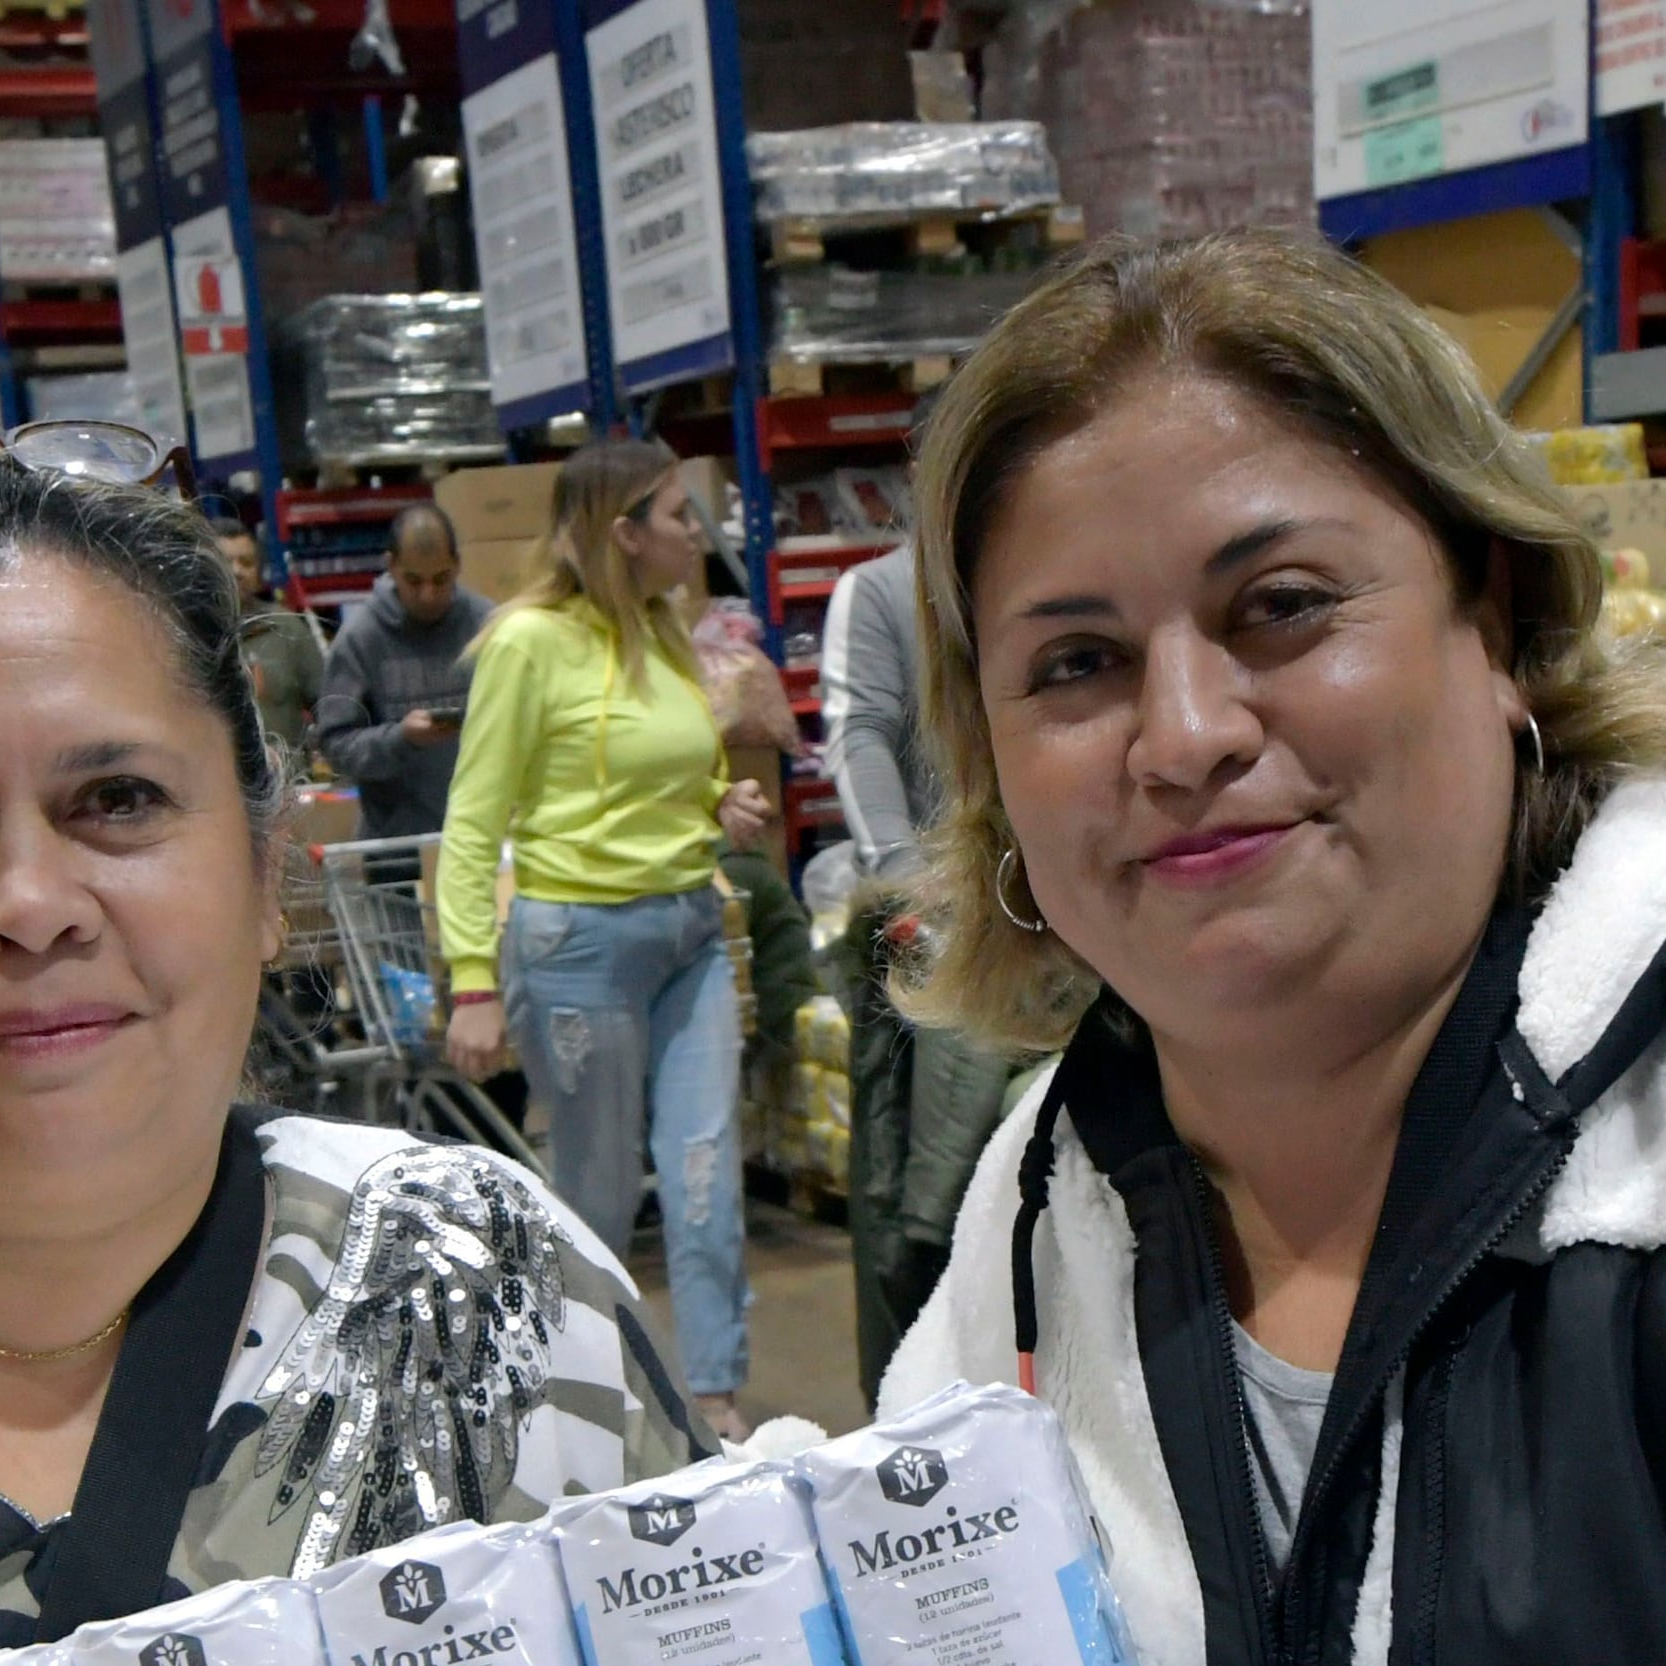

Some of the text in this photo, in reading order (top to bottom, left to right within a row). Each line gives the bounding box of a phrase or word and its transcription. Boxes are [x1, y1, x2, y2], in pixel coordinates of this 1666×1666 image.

[847, 1499, 1019, 1577] Morixe
[595, 1544, 764, 1613] Morixe
[900, 1558, 945, 1578] DESDE
[643, 1598, 689, 1616] DESDE
[914, 1577, 990, 1610] MUFFINS
[939, 1590, 995, 1616] unidades)
[656, 1618, 732, 1648] MUFFINS
